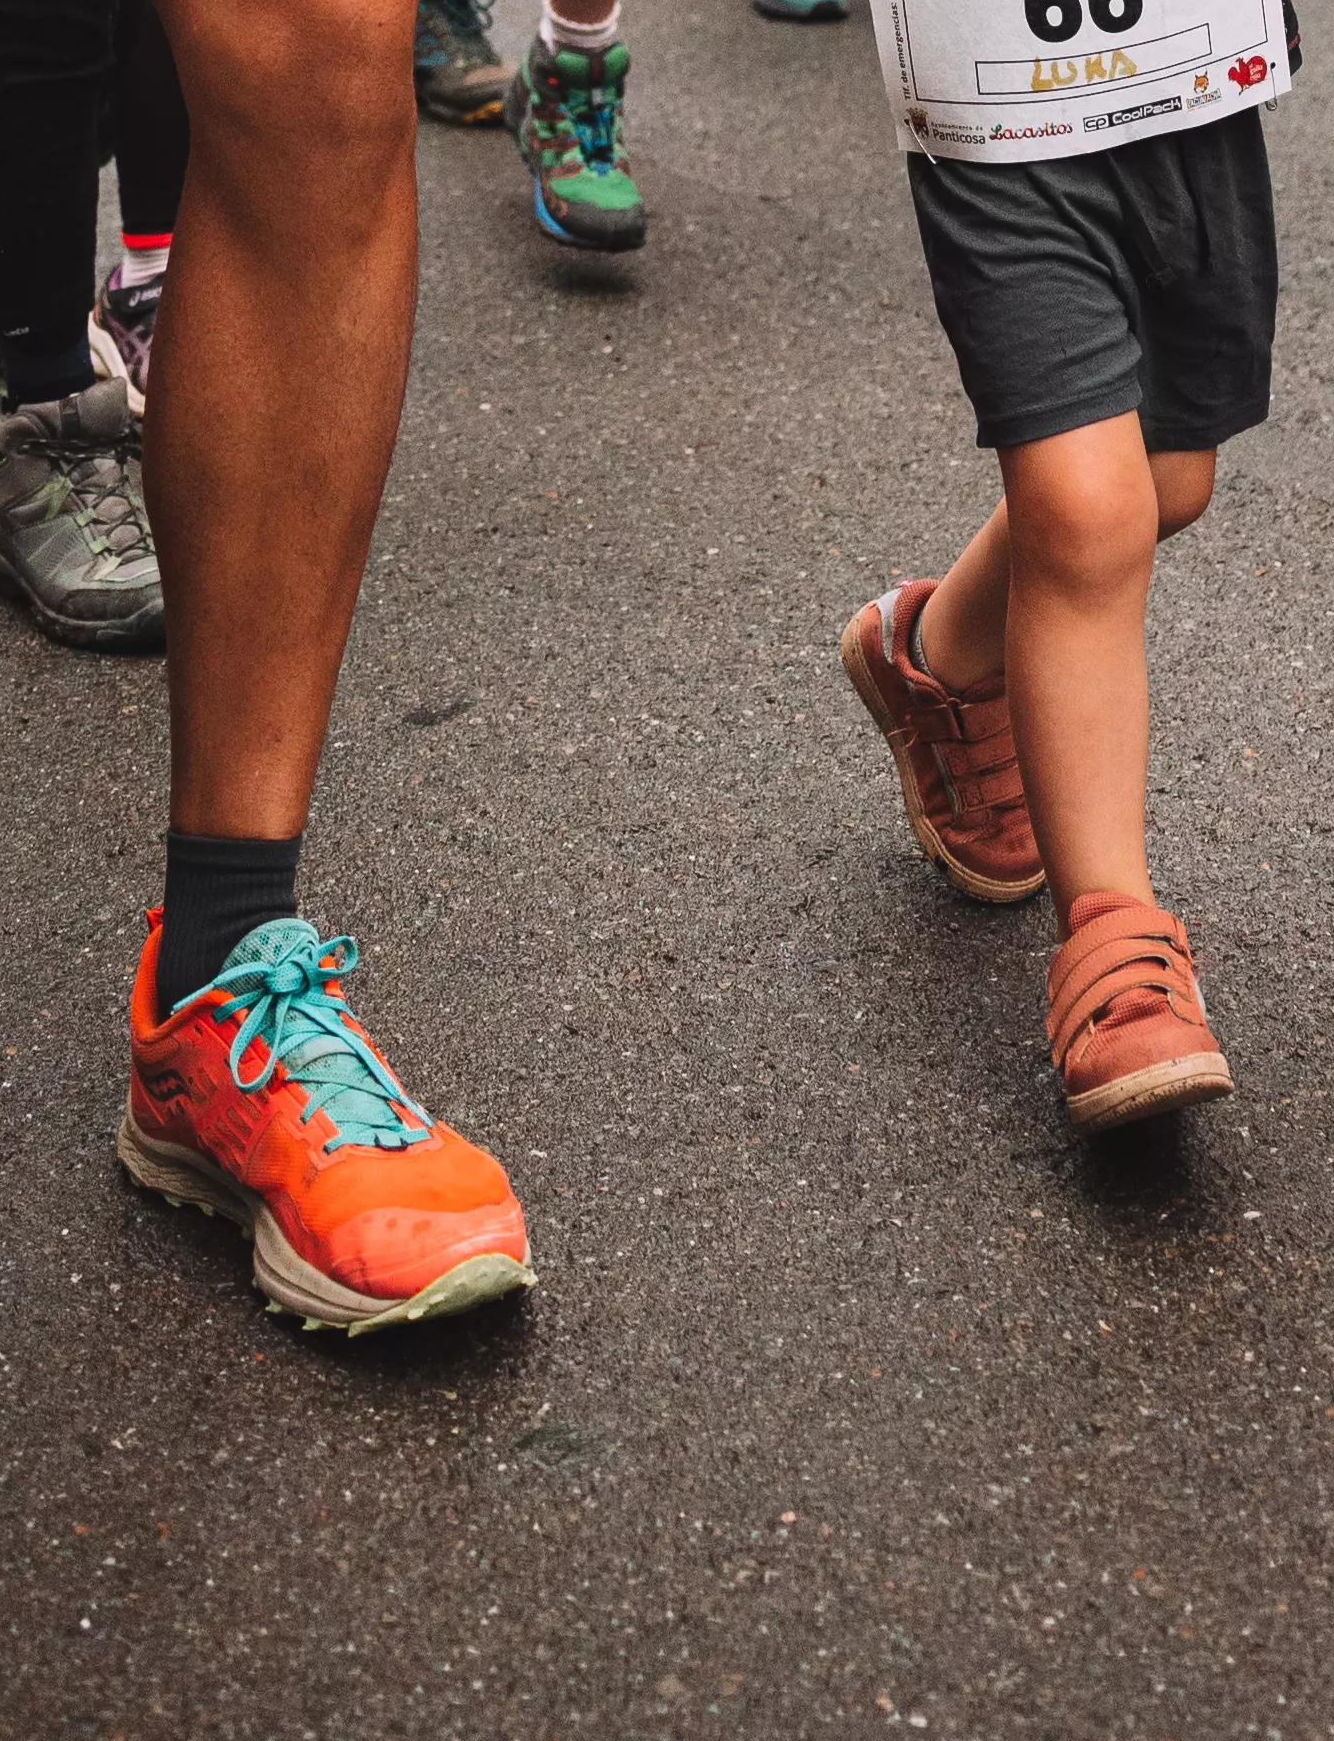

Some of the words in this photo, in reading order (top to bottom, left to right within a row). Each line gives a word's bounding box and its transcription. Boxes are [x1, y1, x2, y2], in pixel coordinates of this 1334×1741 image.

[901, 70, 909, 84] de
[933, 128, 986, 145] Panticosa
[989, 121, 1074, 141] Lacasitos
